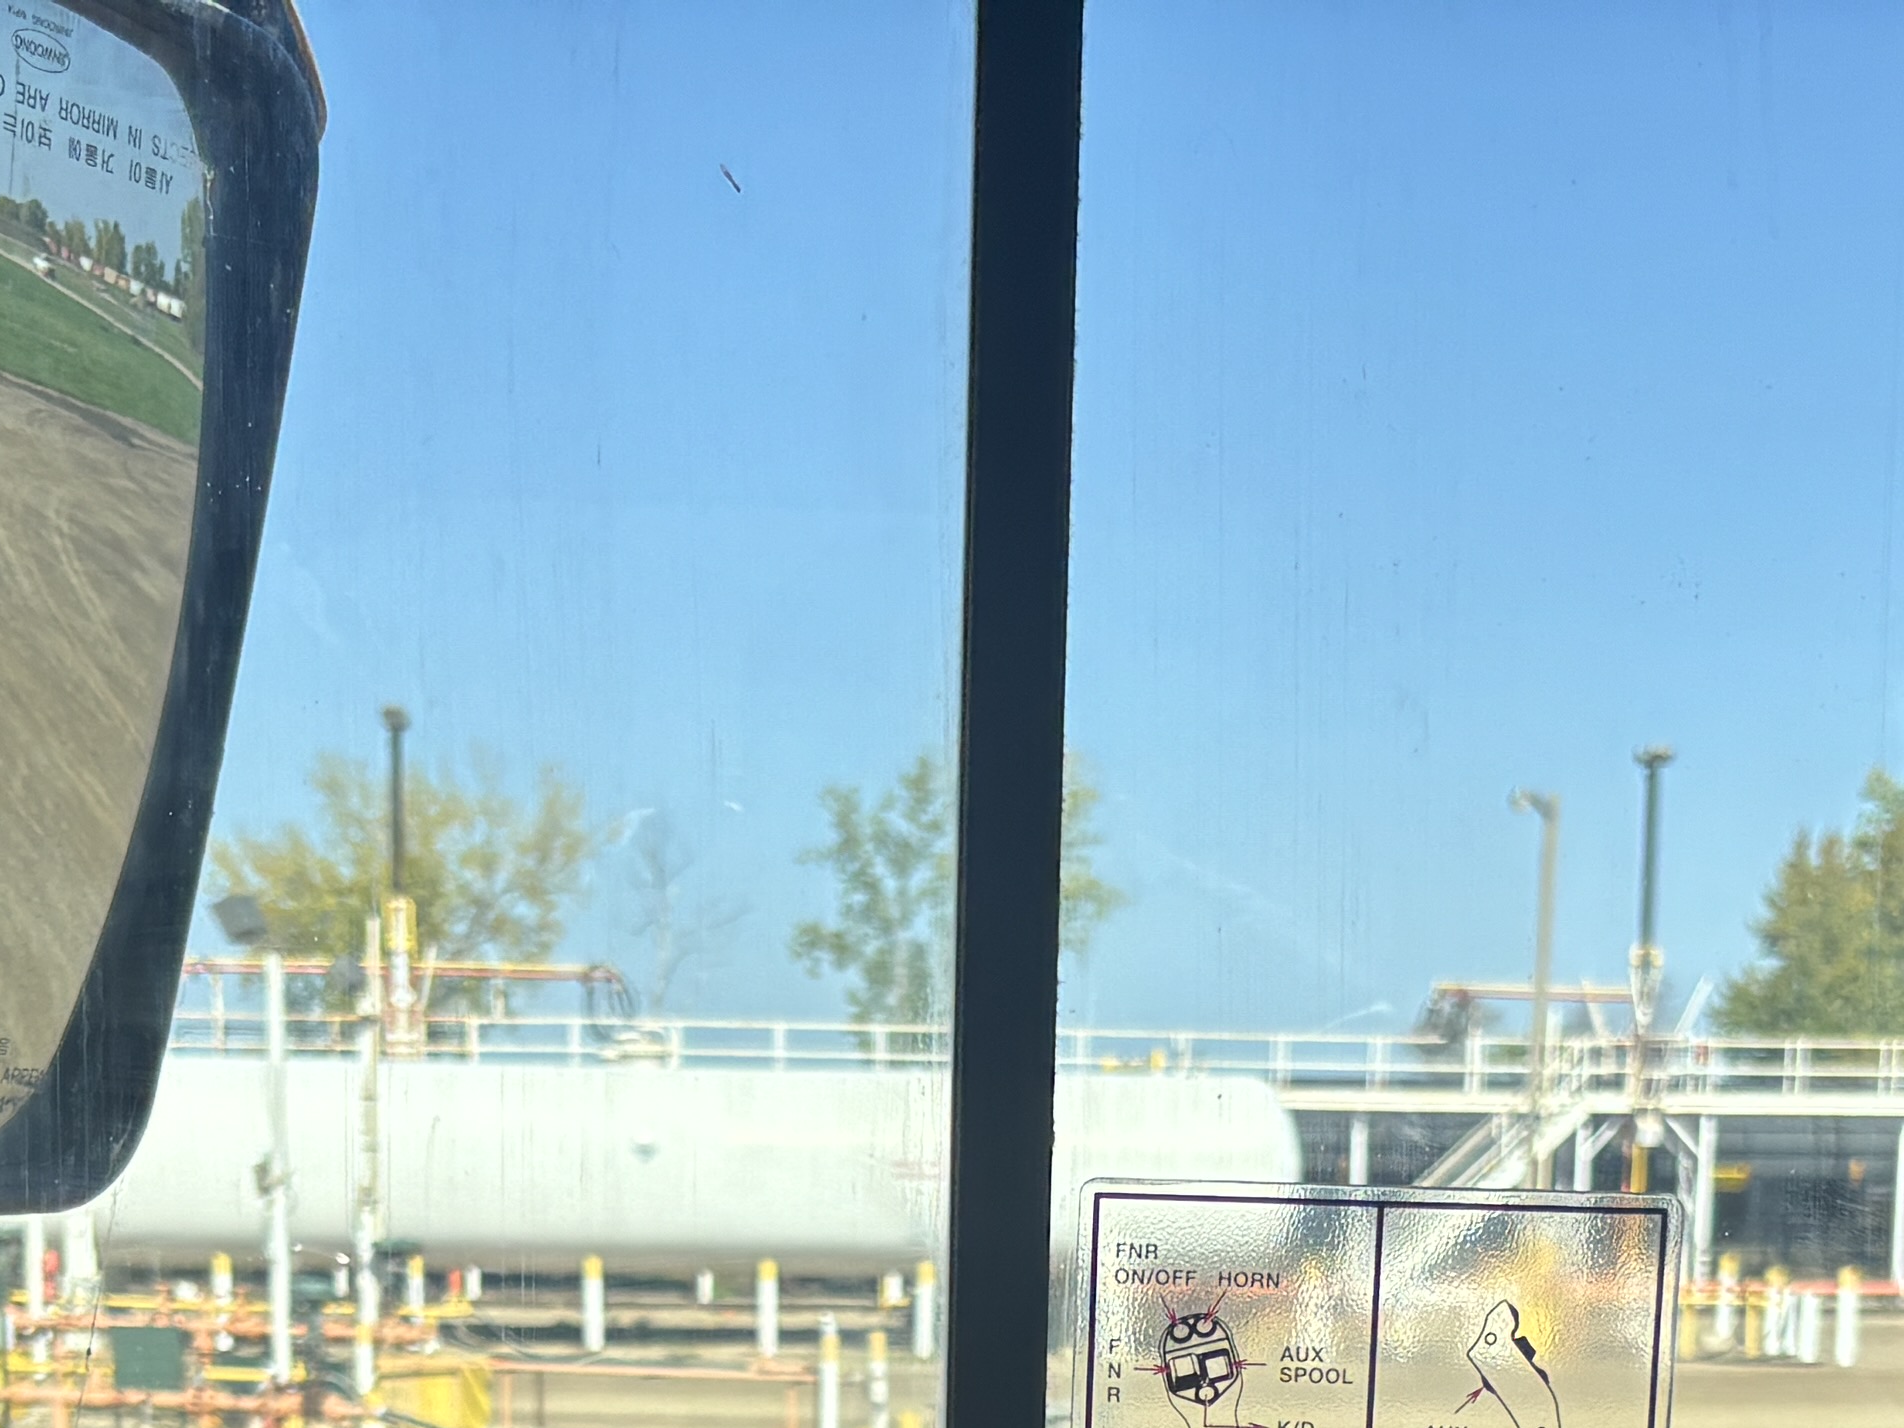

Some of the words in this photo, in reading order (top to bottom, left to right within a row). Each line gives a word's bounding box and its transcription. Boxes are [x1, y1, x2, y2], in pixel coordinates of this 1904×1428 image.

[15, 79, 52, 112] ARE
[58, 97, 119, 141] MIRROR
[3, 112, 53, 151] 보이는
[127, 125, 144, 148] IN
[67, 136, 116, 175] 거울에
[128, 163, 174, 196] 사물이
[1115, 1242, 1159, 1260] FNR
[1114, 1267, 1197, 1288] ON/OFF
[1218, 1270, 1281, 1288] HORN
[1110, 1339, 1120, 1356] F
[1281, 1346, 1325, 1364] AUX
[1109, 1362, 1121, 1379] N
[1279, 1367, 1353, 1385] SPOOL
[1107, 1386, 1121, 1404] R
